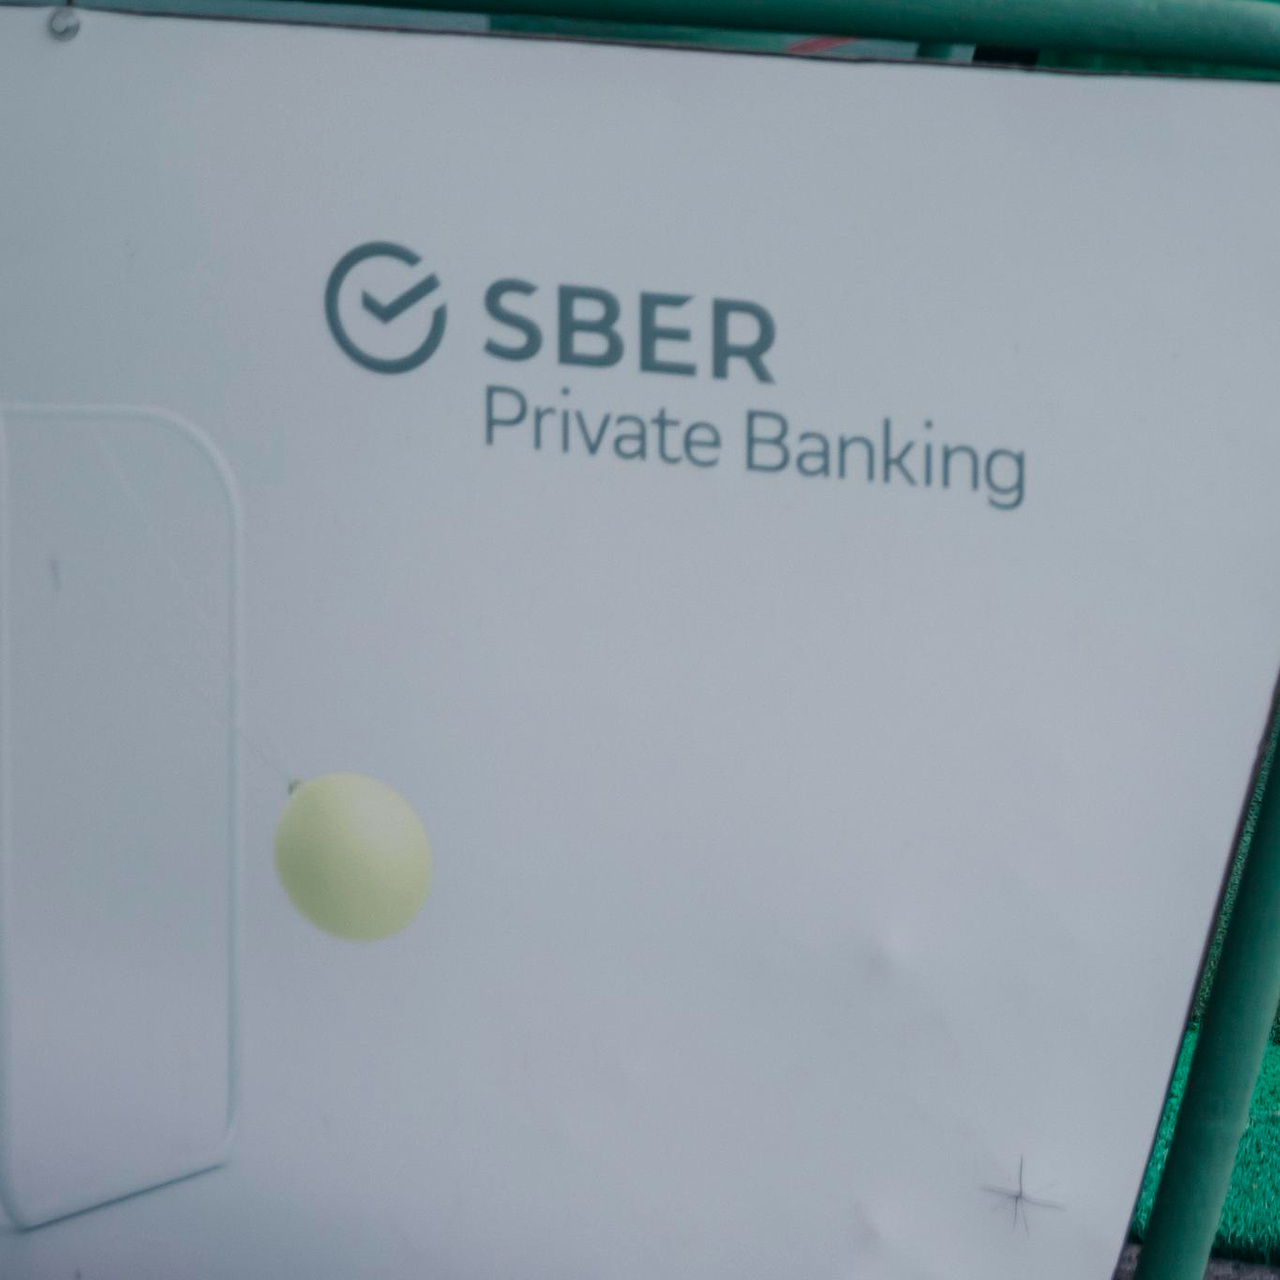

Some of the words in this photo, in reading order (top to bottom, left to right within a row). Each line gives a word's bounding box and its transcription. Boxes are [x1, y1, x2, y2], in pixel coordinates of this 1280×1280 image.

[483, 278, 776, 384] SBER
[485, 384, 723, 469] Private
[745, 409, 1026, 511] Banking
